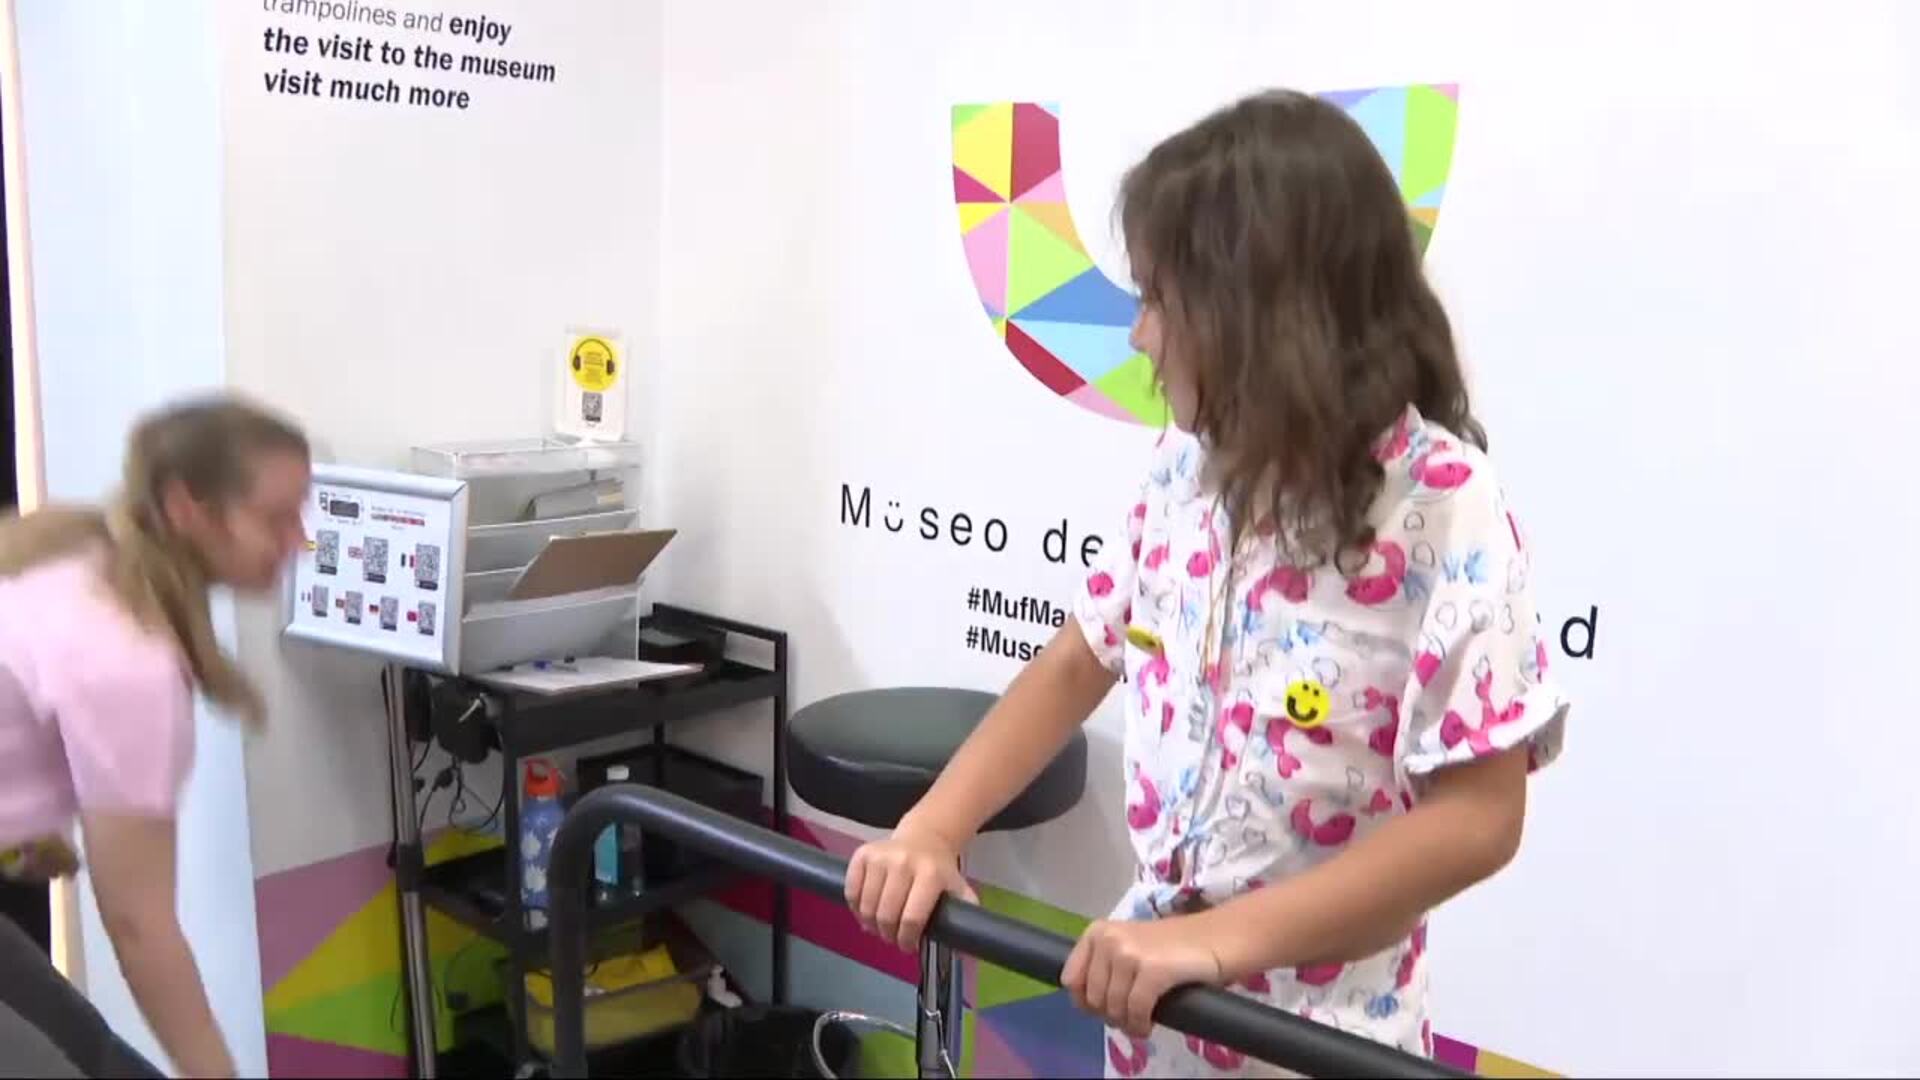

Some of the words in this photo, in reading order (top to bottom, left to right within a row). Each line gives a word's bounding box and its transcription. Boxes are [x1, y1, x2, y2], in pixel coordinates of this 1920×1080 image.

[403, 12, 443, 32] and
[449, 15, 512, 46] enjoy
[263, 27, 309, 55] the
[317, 34, 373, 62] visit
[381, 41, 405, 66] to
[414, 45, 453, 71] the
[461, 53, 556, 83] museum
[263, 68, 322, 97] visit
[330, 78, 400, 104] much
[408, 84, 470, 109] more
